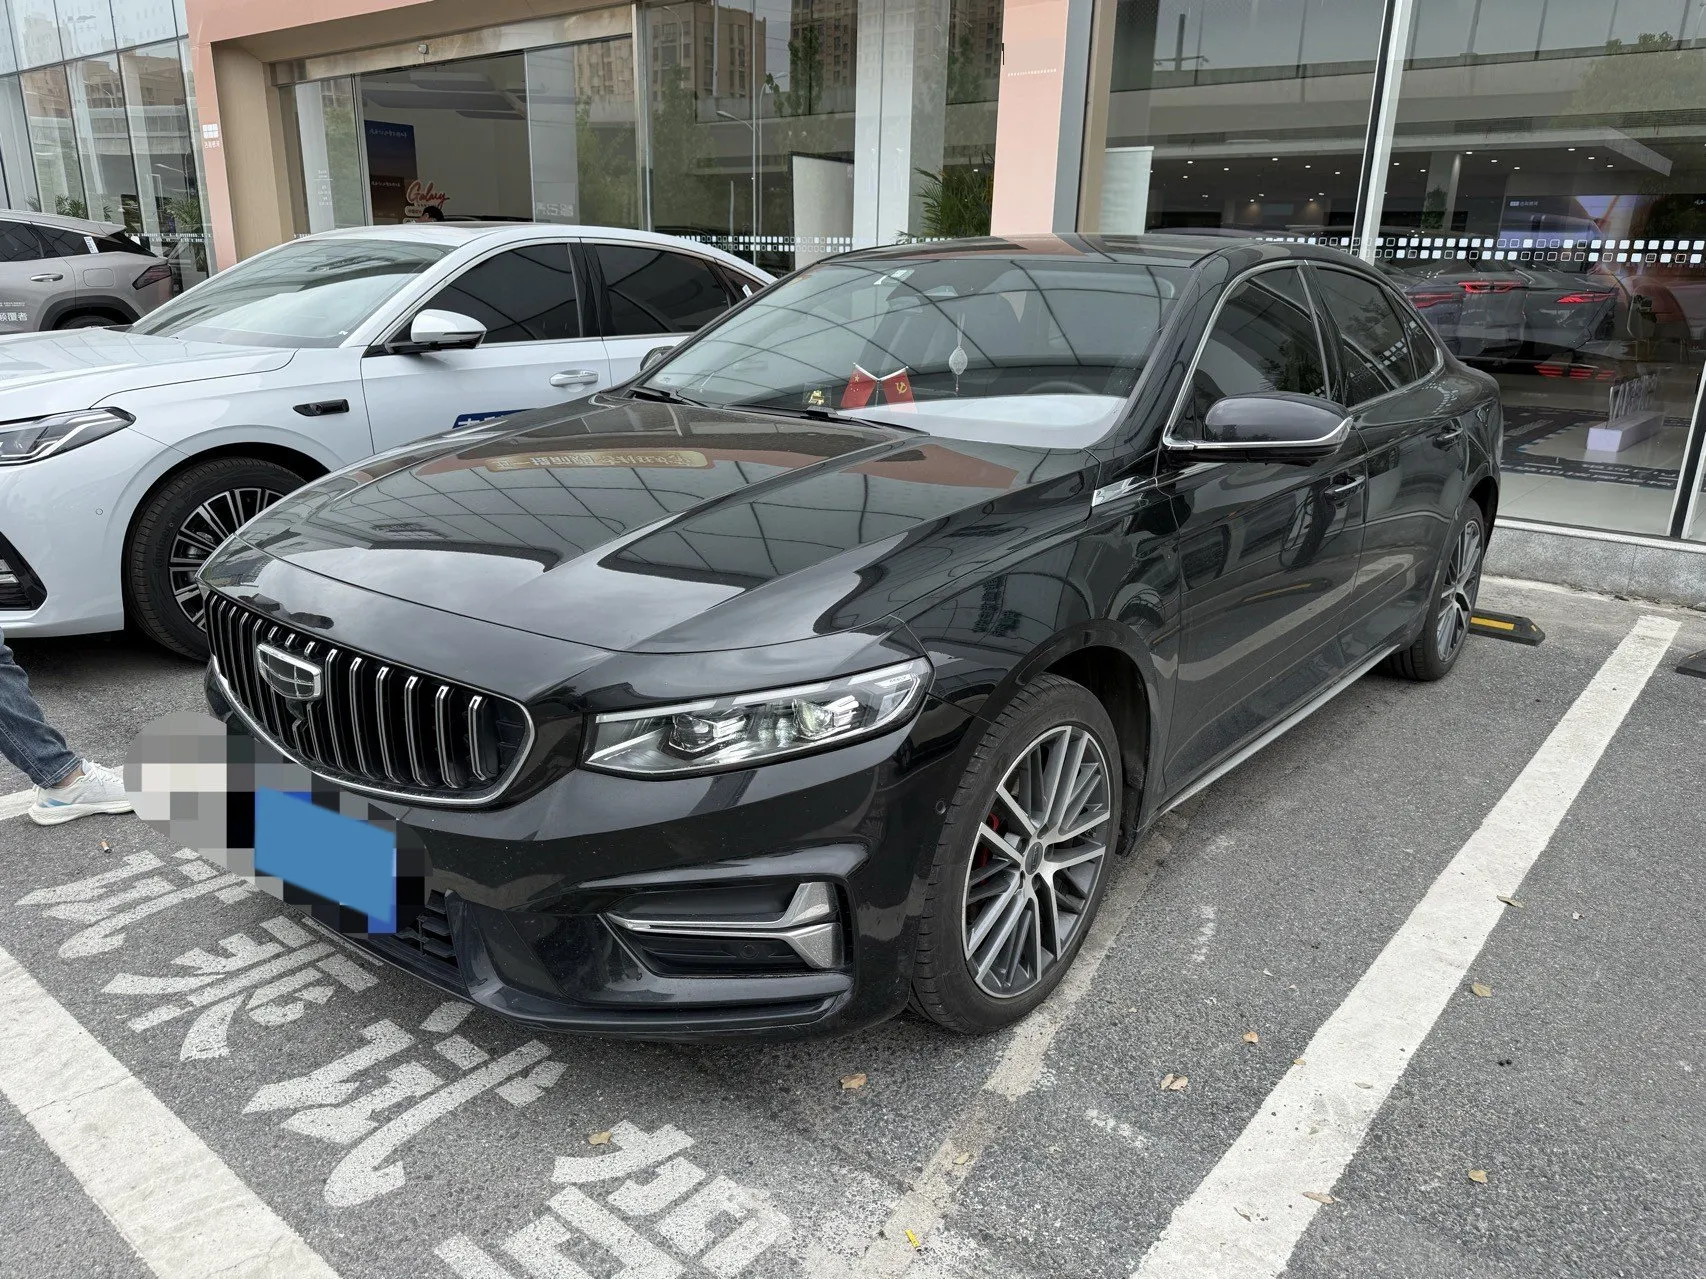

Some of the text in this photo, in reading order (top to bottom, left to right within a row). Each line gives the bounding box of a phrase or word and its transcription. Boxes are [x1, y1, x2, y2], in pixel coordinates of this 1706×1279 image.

[407, 181, 450, 209] Galaxy
[14, 847, 790, 1279] 试乘试驾
